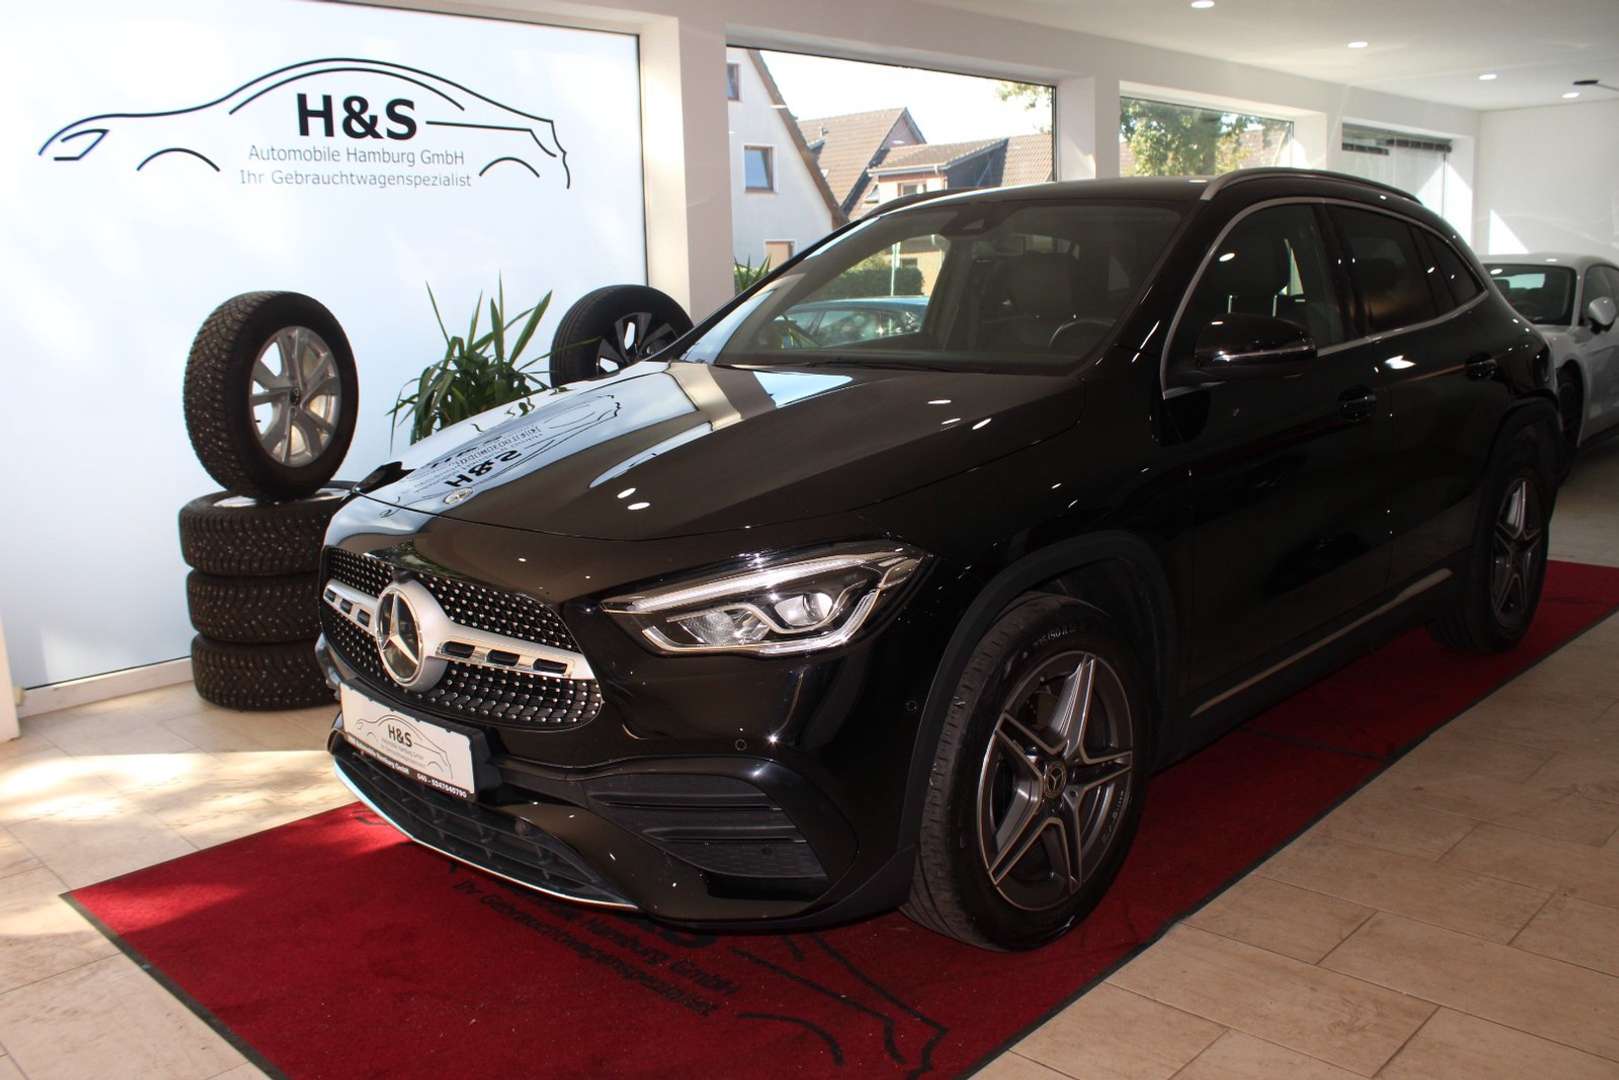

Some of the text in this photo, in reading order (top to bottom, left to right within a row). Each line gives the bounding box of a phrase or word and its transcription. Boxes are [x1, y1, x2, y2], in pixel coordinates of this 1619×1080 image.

[297, 93, 418, 141] H&S
[248, 145, 465, 166] Automobile Hamburg GmbH
[240, 169, 472, 189] Ihr Gebrauchtwagenspezialist
[387, 724, 414, 749] H&S
